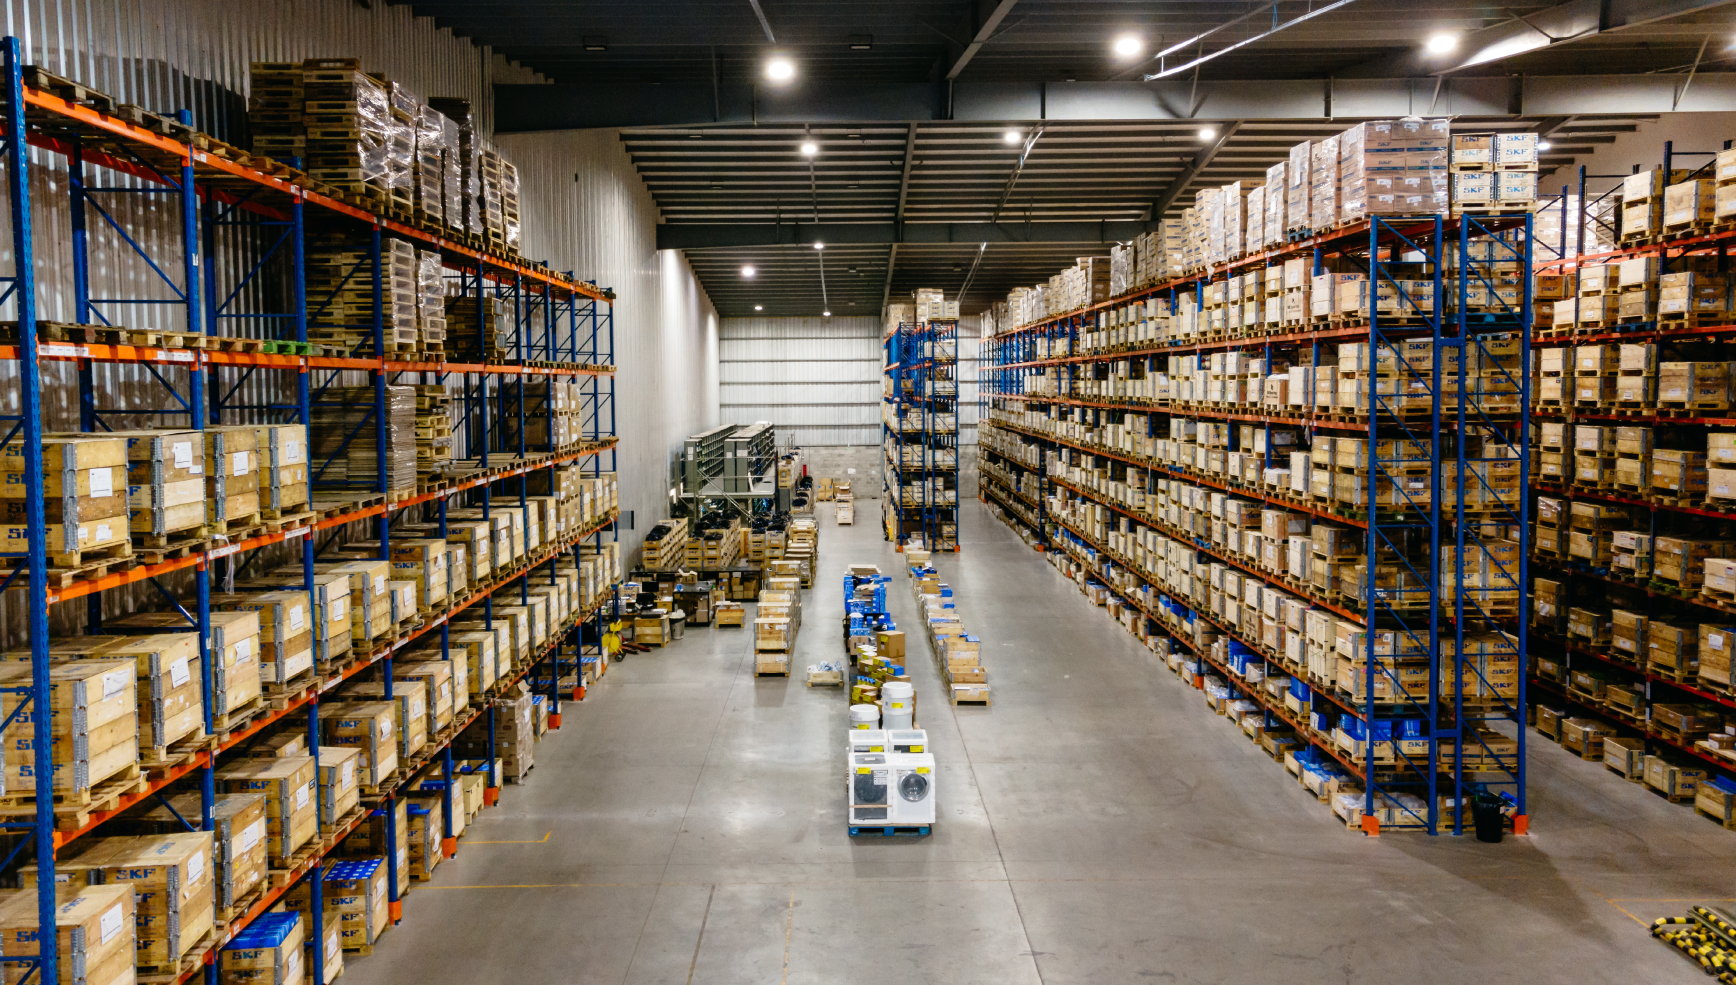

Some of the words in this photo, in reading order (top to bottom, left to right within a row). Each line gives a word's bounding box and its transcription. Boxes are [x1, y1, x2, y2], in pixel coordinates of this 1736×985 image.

[240, 781, 271, 790] SKF
[116, 868, 156, 880] SKF
[331, 897, 358, 905] SKF
[232, 950, 264, 960] SKF
